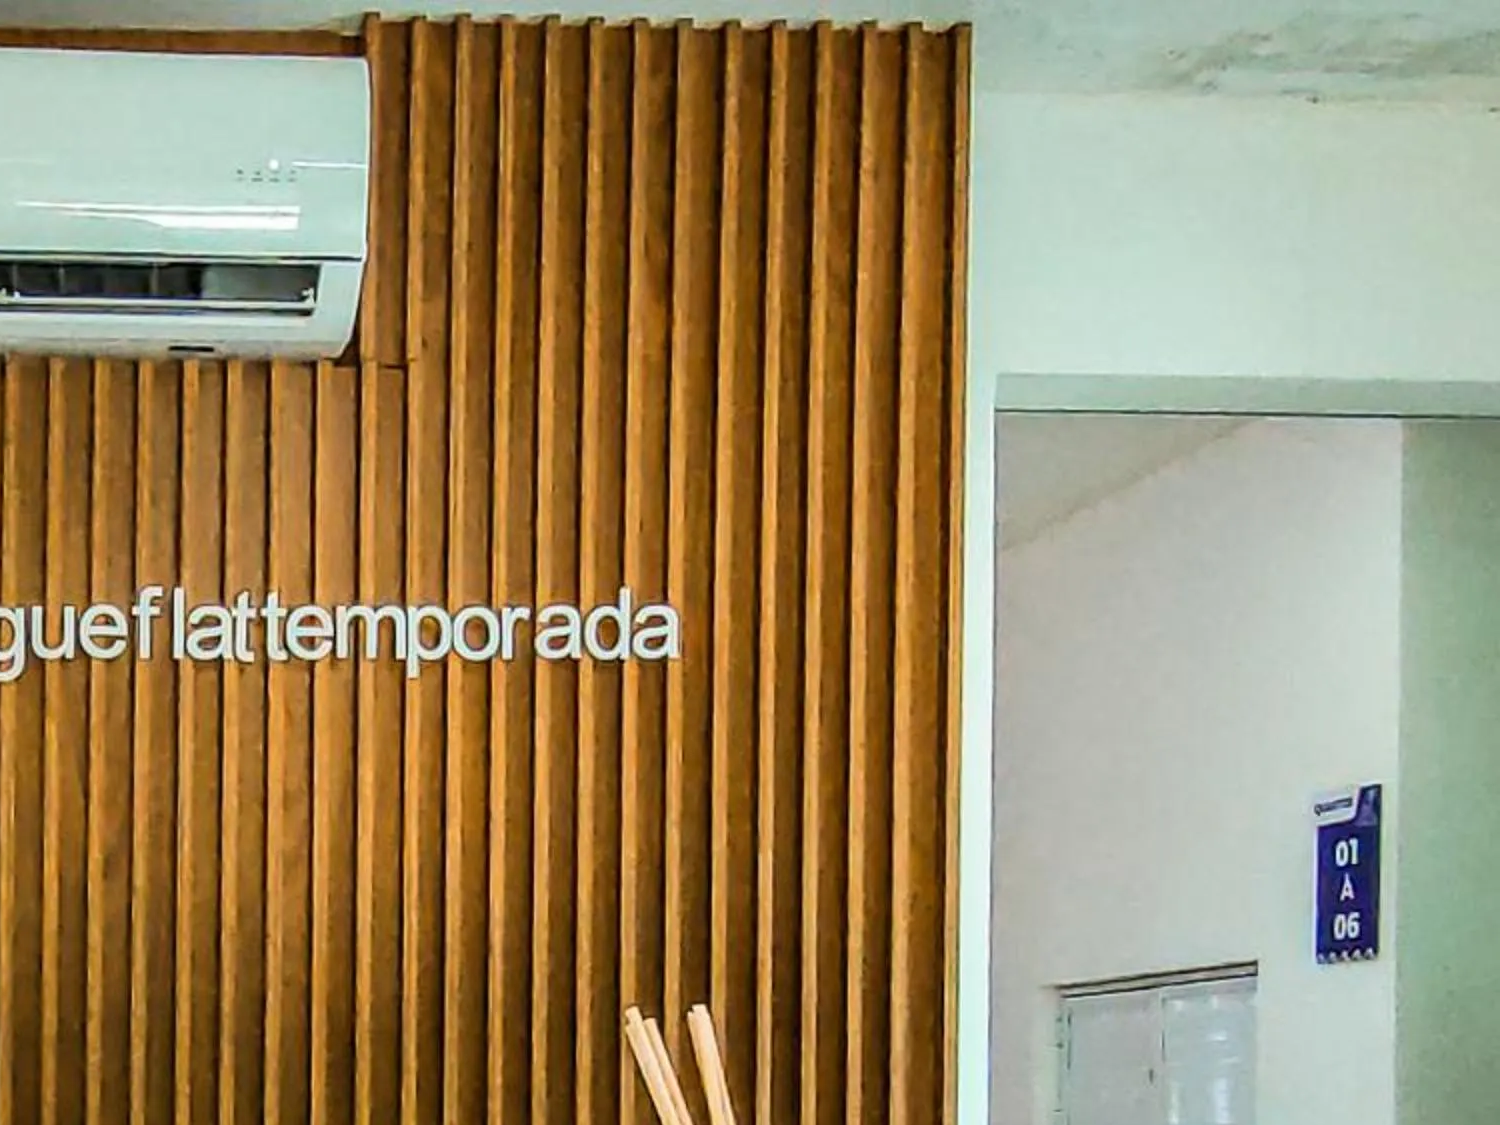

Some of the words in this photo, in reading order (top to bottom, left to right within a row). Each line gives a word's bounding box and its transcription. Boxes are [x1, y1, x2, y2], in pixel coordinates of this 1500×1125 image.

[1335, 837, 1359, 868] 01
[1340, 872, 1355, 901] A
[1333, 911, 1361, 940] 06
